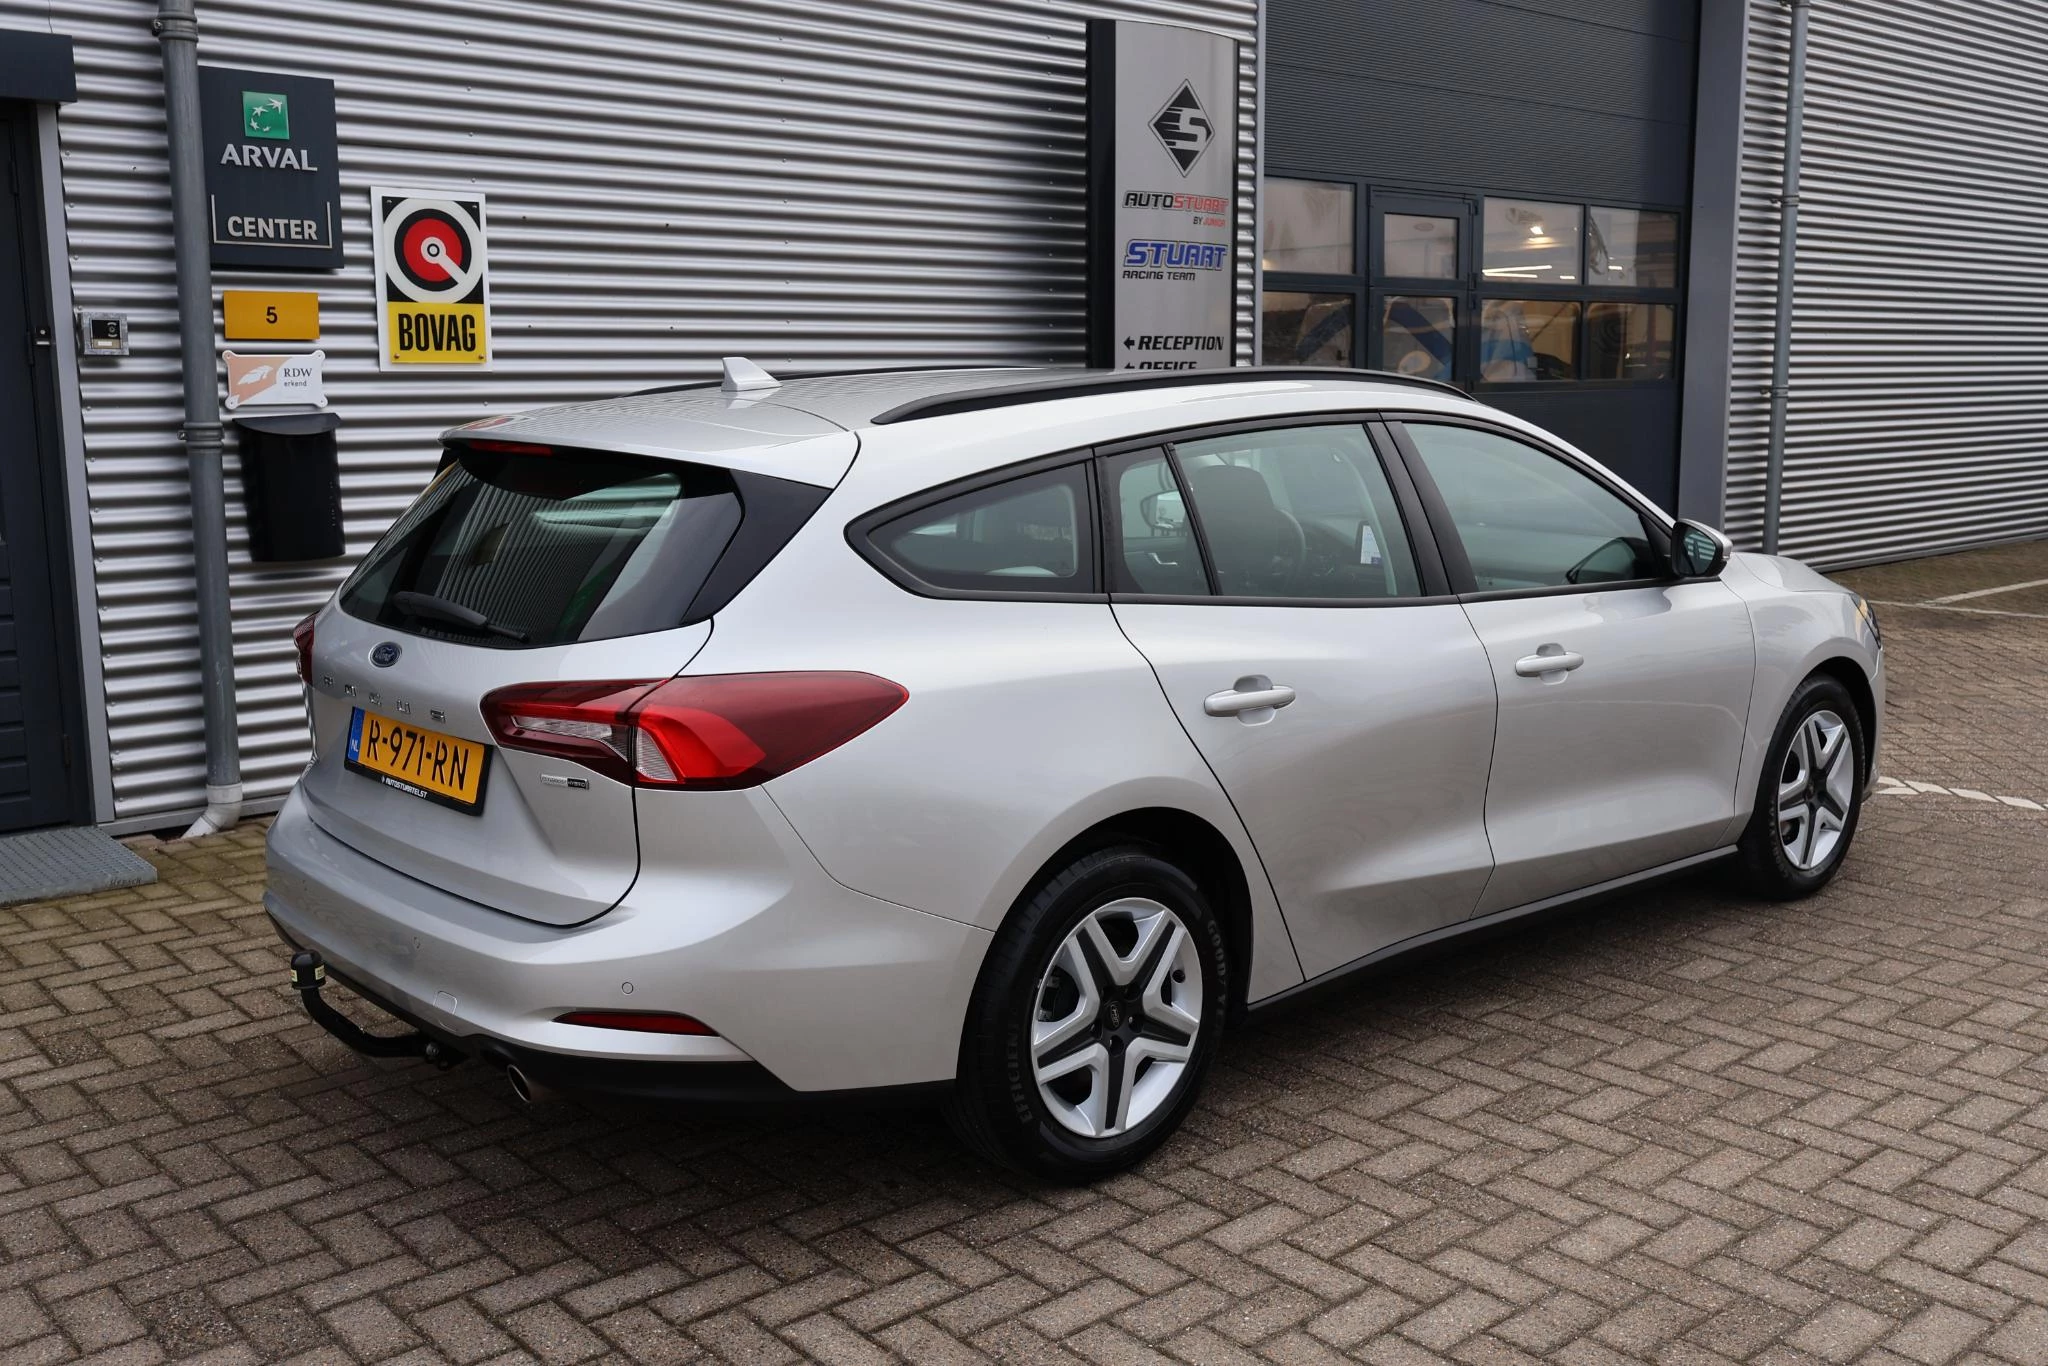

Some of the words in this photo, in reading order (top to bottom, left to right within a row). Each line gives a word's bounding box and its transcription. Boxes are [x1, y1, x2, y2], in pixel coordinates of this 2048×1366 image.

[221, 143, 318, 171] ARVAL
[1123, 191, 1228, 214] AUTOSTUART
[227, 215, 318, 241] CENTER
[1193, 216, 1203, 225] BY
[1124, 239, 1228, 271] STUART
[1122, 270, 1164, 280] RACING
[1167, 271, 1196, 281] TEAM
[265, 305, 278, 324] 5
[398, 312, 476, 352] BOVAG
[1137, 335, 1224, 351] RECEPTION
[284, 367, 312, 377] RDW
[284, 378, 307, 387] erkend
[351, 739, 359, 753] NL
[366, 719, 469, 791] R-971-RN
